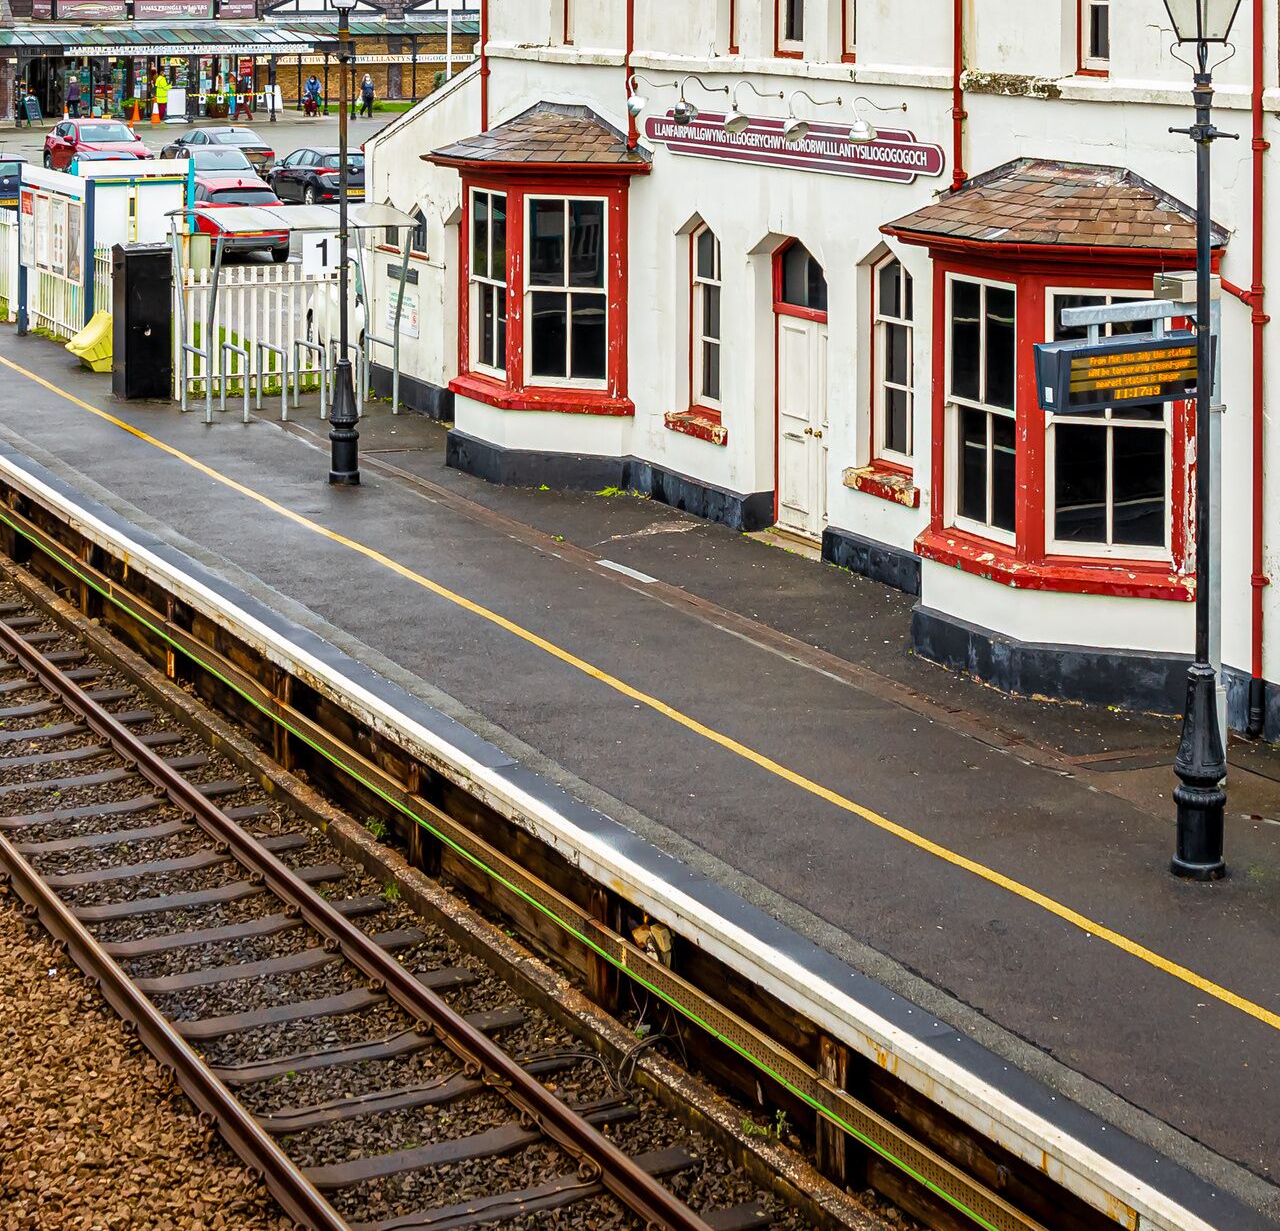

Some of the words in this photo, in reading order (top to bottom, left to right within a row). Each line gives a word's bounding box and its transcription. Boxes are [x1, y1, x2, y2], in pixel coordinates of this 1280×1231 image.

[315, 238, 328, 267] 1
[1089, 357, 1106, 366] From
[1167, 348, 1192, 357] station
[1095, 378, 1122, 388] nearest
[1125, 375, 1149, 385] station
[1158, 372, 1181, 382] Bangor
[1114, 385, 1161, 400] 11:17:13
